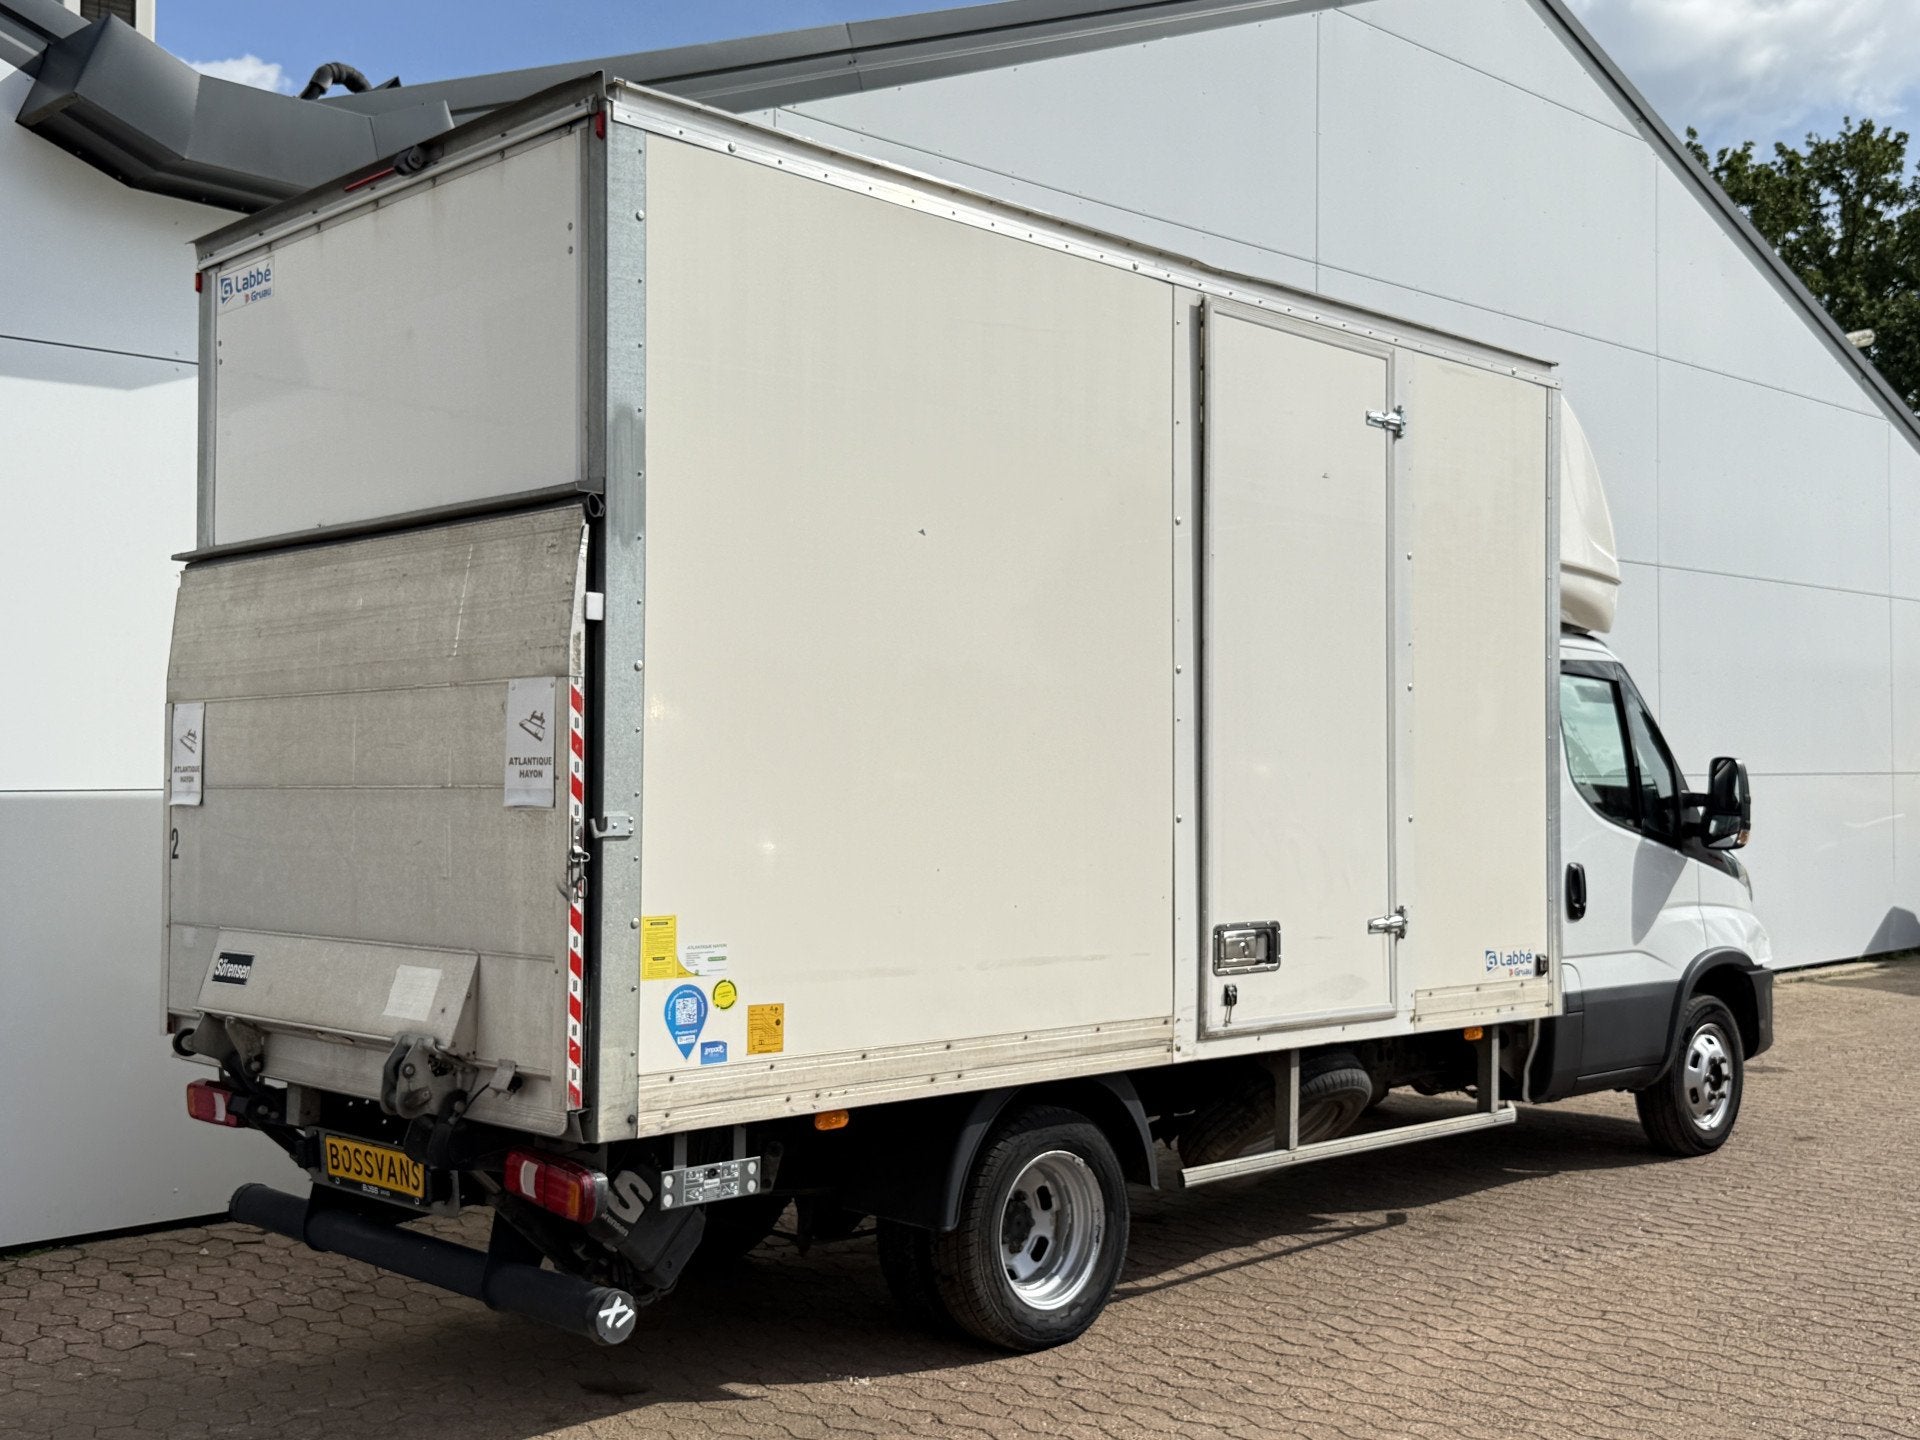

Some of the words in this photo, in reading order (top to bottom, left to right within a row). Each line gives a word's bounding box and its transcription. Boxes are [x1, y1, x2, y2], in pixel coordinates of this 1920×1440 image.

[236, 263, 271, 293] Labbé
[250, 288, 272, 302] Gruau
[174, 765, 200, 773] ATLANTIQUE
[509, 756, 552, 766] ATLANTIQUE
[519, 769, 543, 779] HAYON
[171, 828, 179, 859] 2
[1499, 949, 1532, 966] Labbé
[214, 958, 251, 979] Sörensen
[1514, 967, 1532, 976] Gruau
[328, 1143, 420, 1191] BOSSVANS
[598, 1296, 635, 1328] X1
